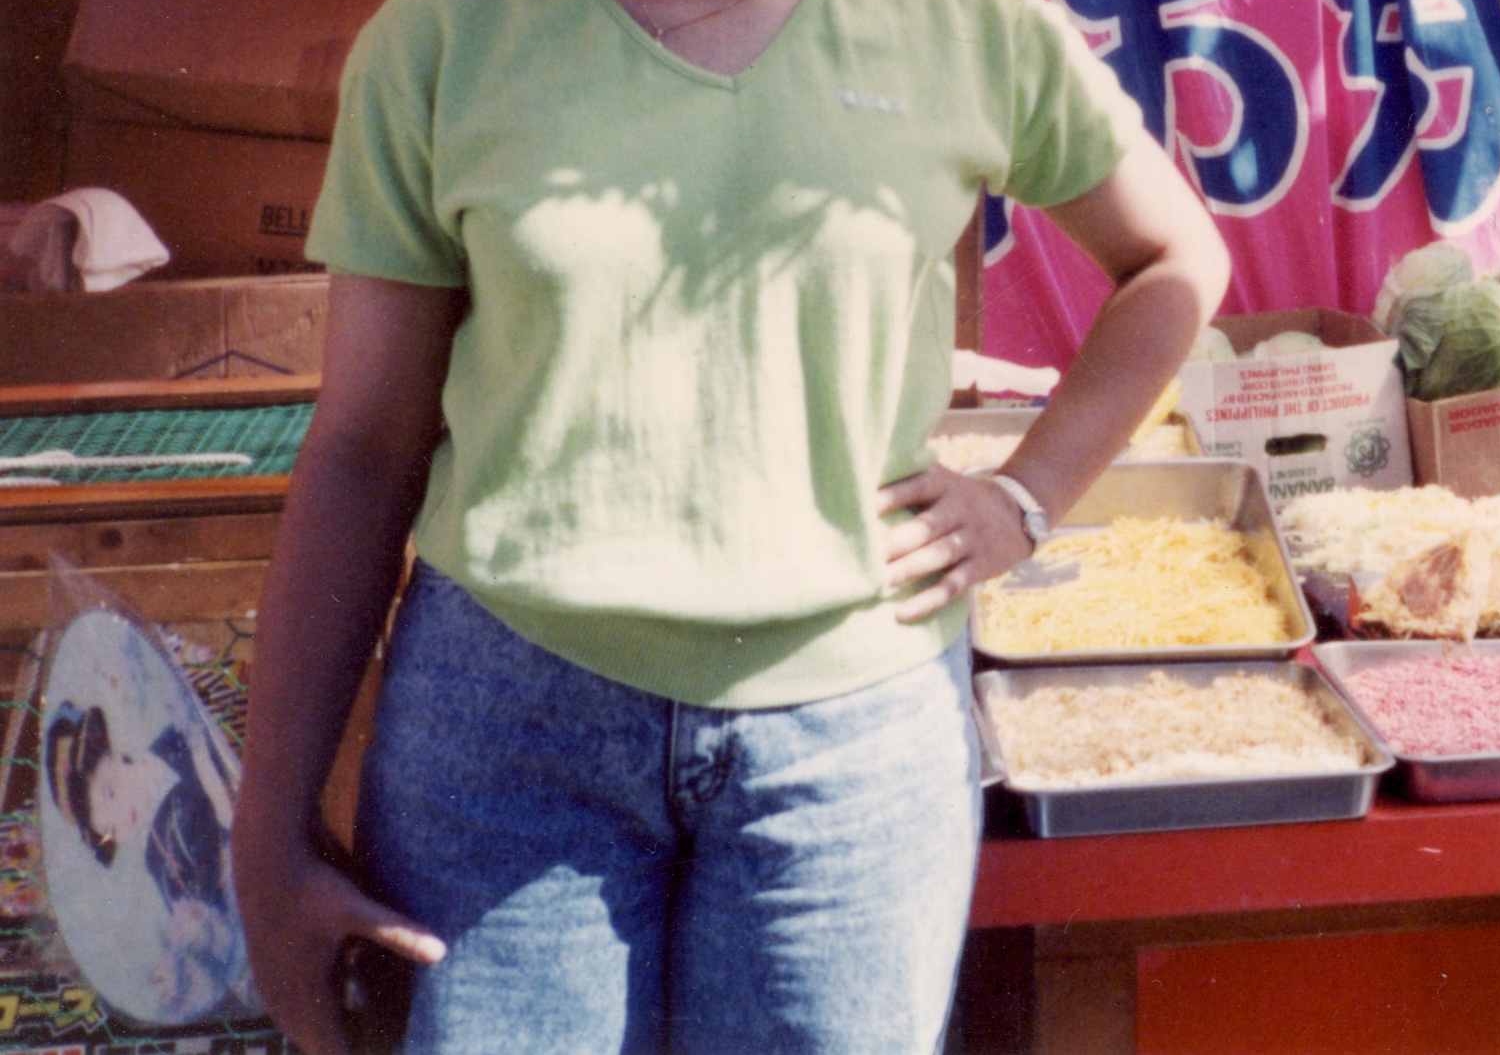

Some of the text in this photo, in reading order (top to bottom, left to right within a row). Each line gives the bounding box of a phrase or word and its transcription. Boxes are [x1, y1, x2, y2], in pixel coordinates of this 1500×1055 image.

[1301, 383, 1353, 398] PRODUCED
[1222, 395, 1236, 406] BY
[1237, 392, 1278, 405] PACKED
[1205, 393, 1370, 423] PRODUCT OF THE PHILIPPINES
